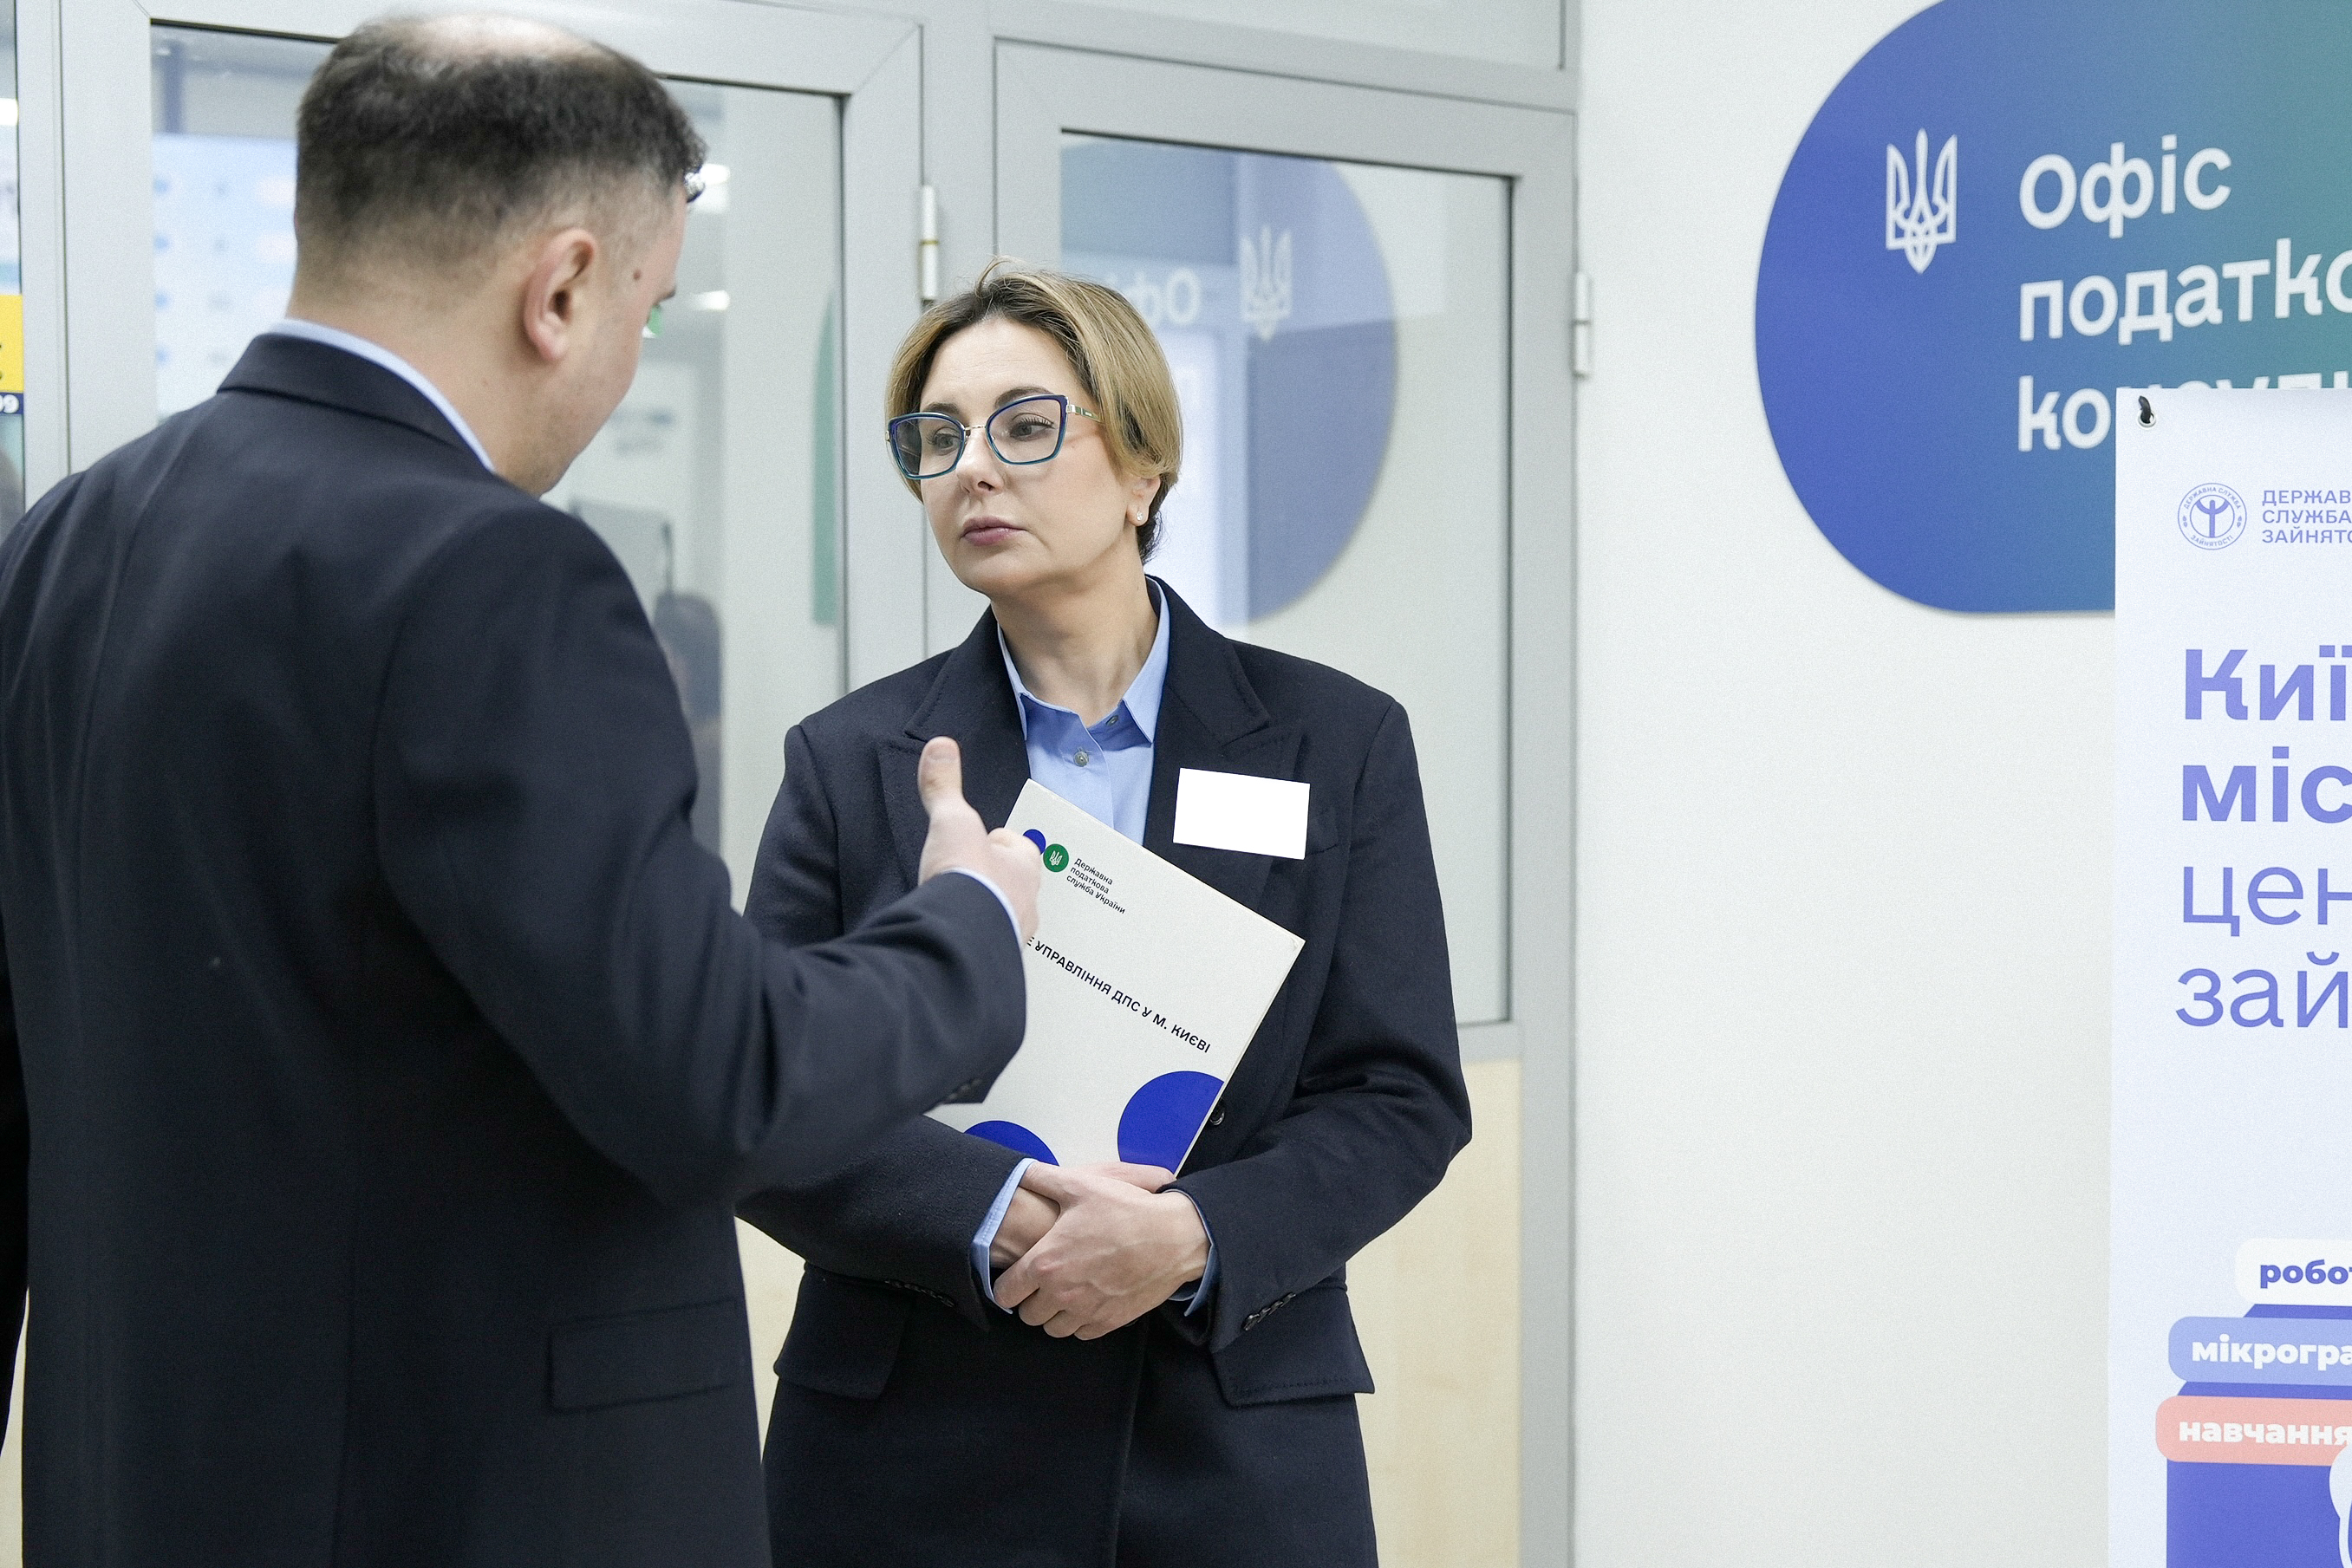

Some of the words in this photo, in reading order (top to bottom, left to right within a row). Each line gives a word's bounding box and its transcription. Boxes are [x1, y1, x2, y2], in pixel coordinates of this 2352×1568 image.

[2019, 133, 2232, 238] Офіс
[2019, 237, 2352, 346] податко
[2262, 490, 2351, 507] ДЕРЖАВ
[2262, 510, 2352, 524] СЛУЖБА
[2185, 645, 2352, 721] Киї
[2182, 746, 2352, 823] міс
[1066, 875, 1094, 895] служба
[1095, 891, 1125, 914] України
[1070, 867, 1109, 894] податкова
[1074, 858, 1113, 885] Державна
[2183, 866, 2352, 937] цен
[1034, 940, 1112, 995] УПРАВЛІННЯ
[1111, 990, 1141, 1012] ДПС
[1141, 1006, 1152, 1018] У
[1152, 1013, 1167, 1030] М.
[1170, 1024, 1211, 1053] КИЄВІ
[2175, 951, 2349, 1029] зай
[2260, 1259, 2352, 1289] робо
[2179, 1421, 2352, 1446] навчання
